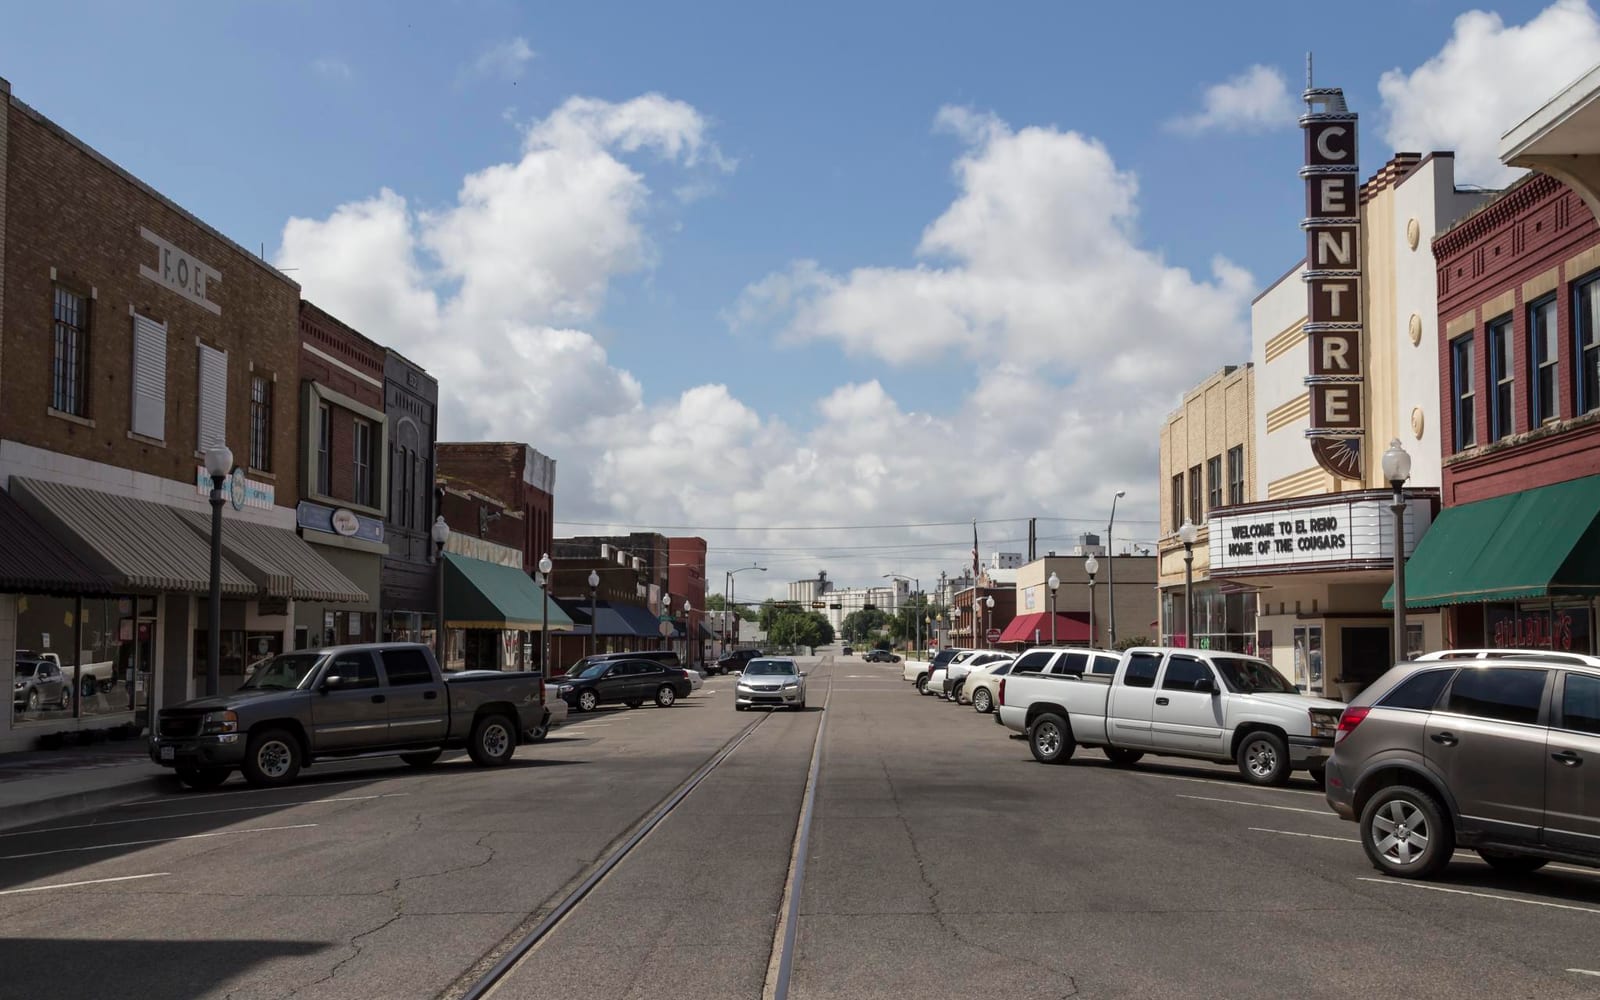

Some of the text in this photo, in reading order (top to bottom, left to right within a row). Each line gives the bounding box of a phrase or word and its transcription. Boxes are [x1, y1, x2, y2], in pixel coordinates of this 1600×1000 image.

[1317, 126, 1351, 423] CENTRE
[1231, 516, 1337, 539] WELCOME TO EL RENO
[1228, 534, 1345, 557] HOME OF THE COUGARS
